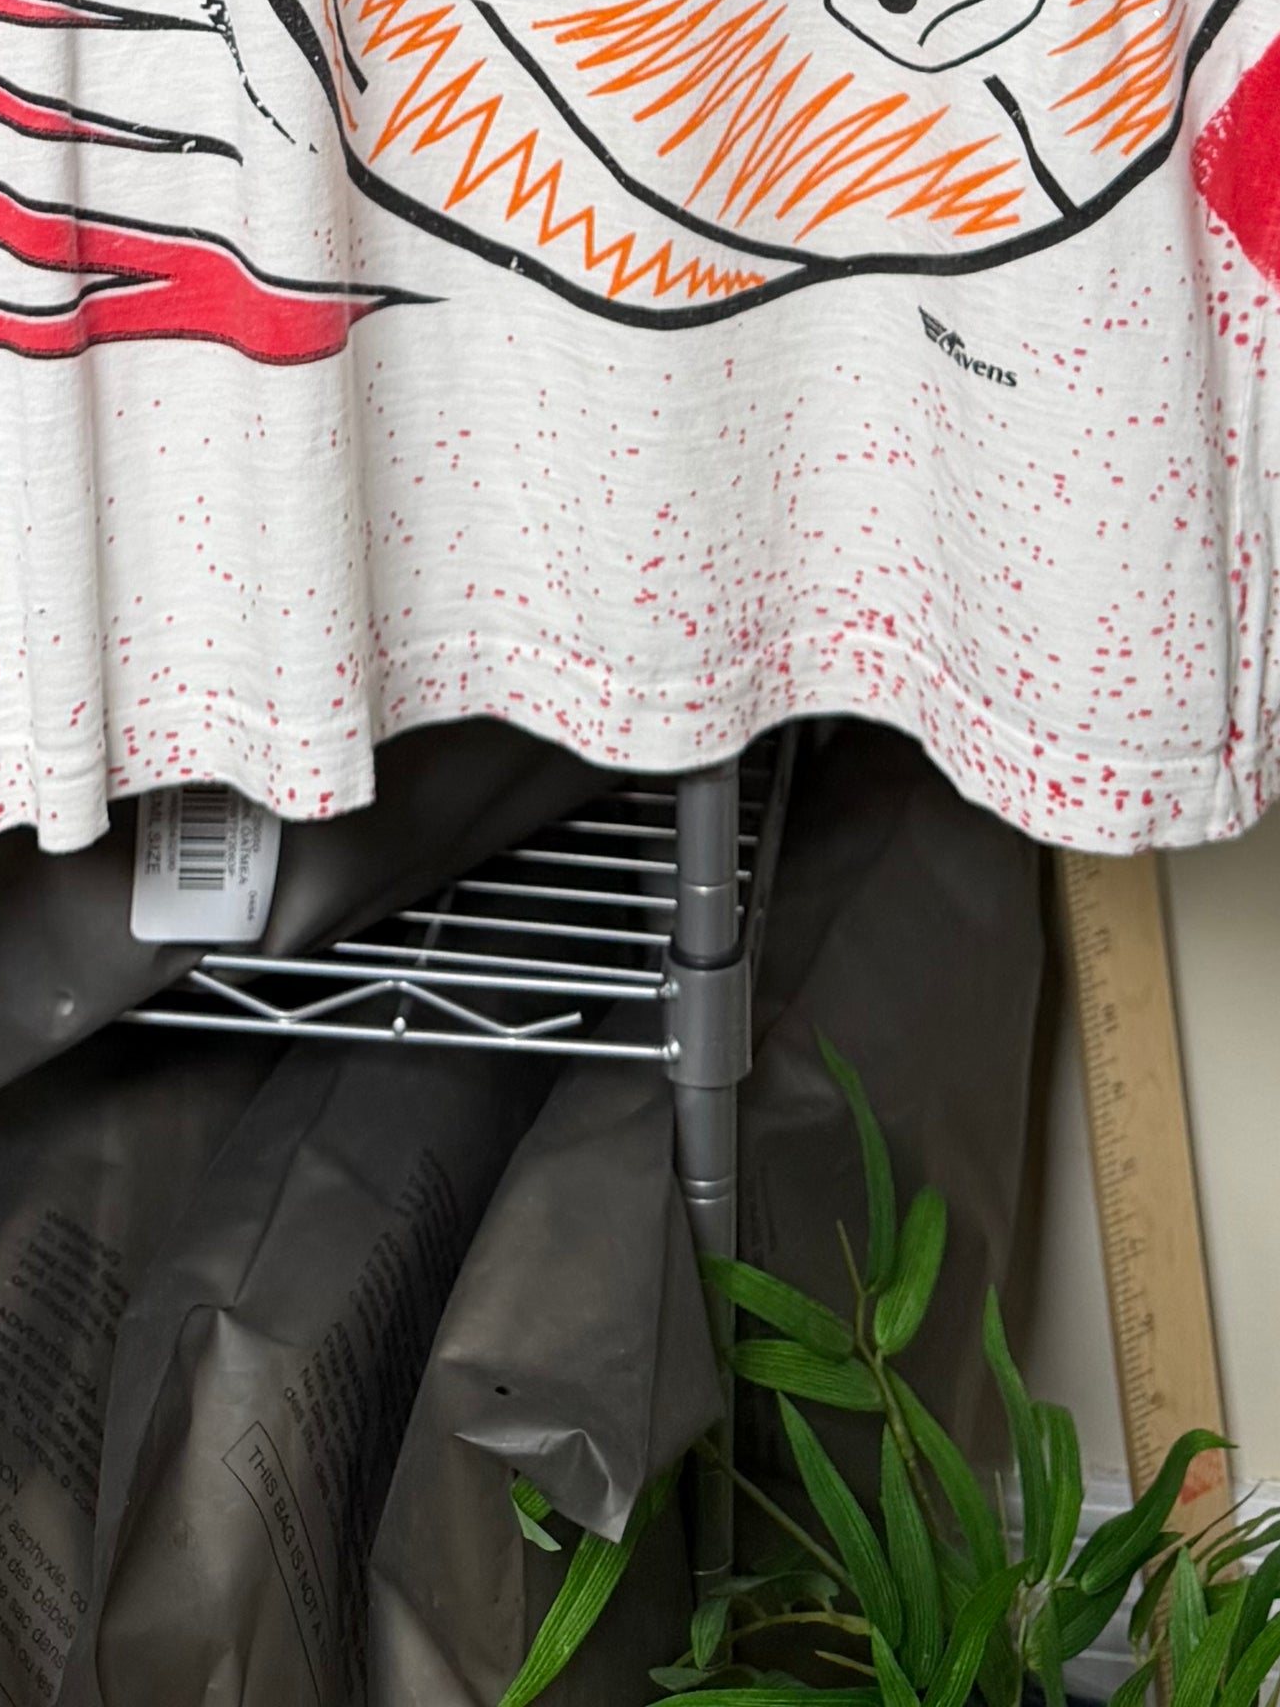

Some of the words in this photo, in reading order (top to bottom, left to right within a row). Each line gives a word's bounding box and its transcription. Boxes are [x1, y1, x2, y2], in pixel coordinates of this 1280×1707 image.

[144, 829, 163, 876] SIZE
[247, 1443, 279, 1498] THIS
[272, 1495, 295, 1548] BAG
[289, 1546, 305, 1572] IS
[5, 1554, 35, 1594] des
[30, 1585, 78, 1642] bébés
